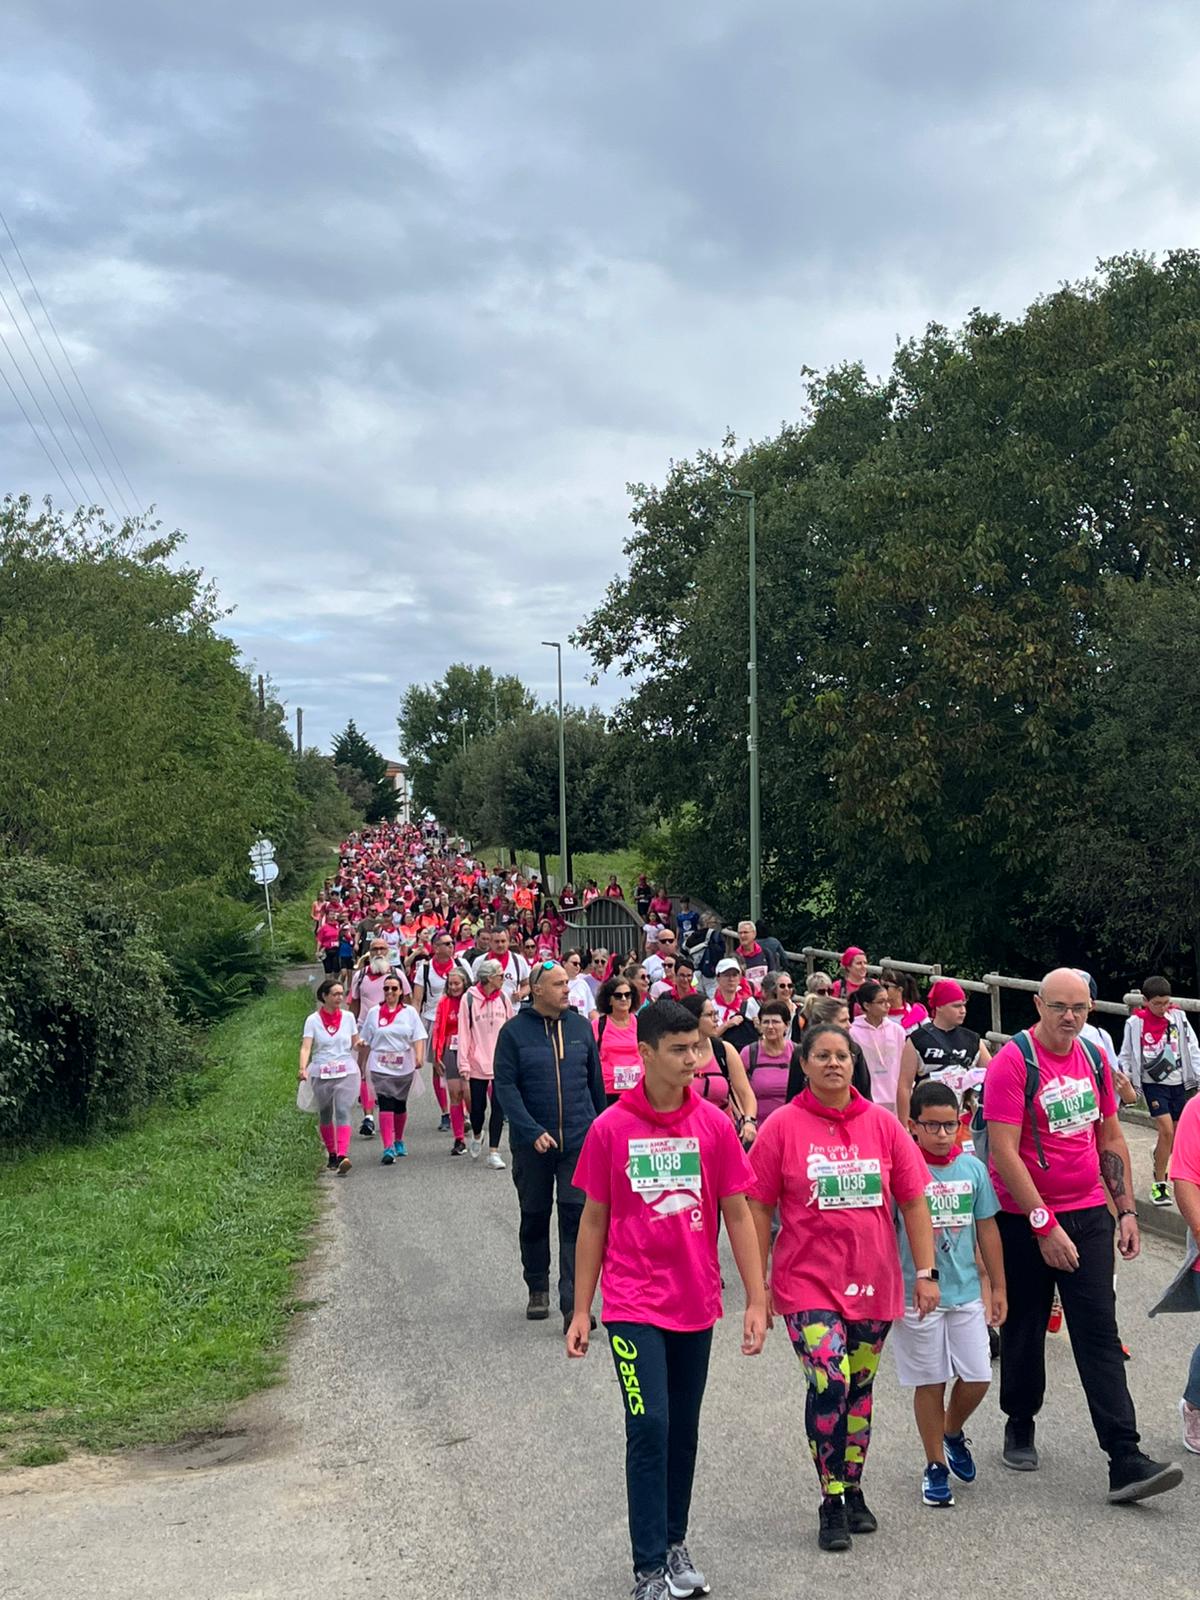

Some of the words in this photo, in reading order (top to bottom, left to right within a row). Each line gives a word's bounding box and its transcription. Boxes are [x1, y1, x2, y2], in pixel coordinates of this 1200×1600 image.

[1061, 1093, 1085, 1114] 1037
[648, 1153, 682, 1172] 1038
[836, 1174, 866, 1191] 1036
[930, 1194, 960, 1211] 2008
[619, 1361, 646, 1416] asics
